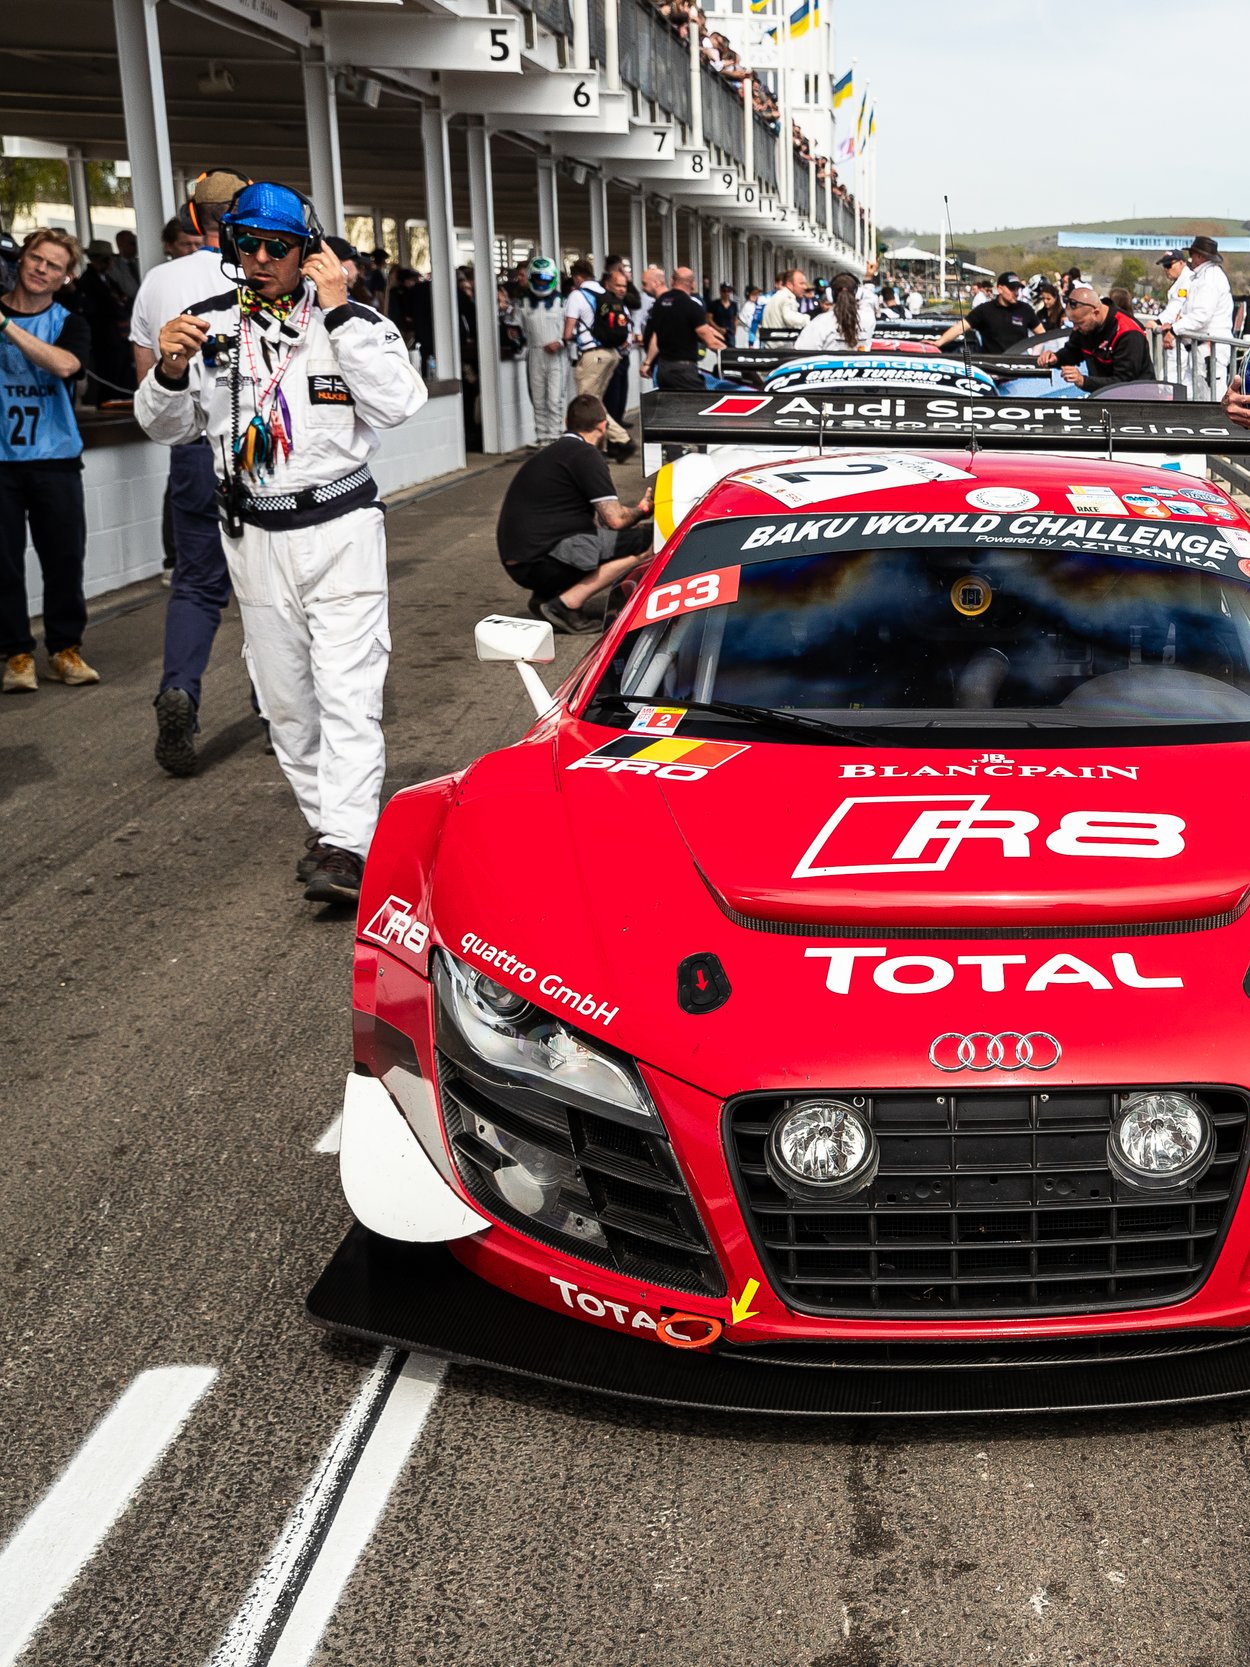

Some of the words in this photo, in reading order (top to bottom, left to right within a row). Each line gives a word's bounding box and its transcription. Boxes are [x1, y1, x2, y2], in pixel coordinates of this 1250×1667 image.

[490, 29, 510, 62] 5
[573, 81, 591, 107] 6
[653, 132, 667, 152] 7
[692, 155, 704, 173] 8
[723, 173, 732, 189] 9
[737, 187, 754, 202] 10
[759, 199, 772, 212] 11
[806, 369, 858, 381] GRAN
[4, 384, 58, 398] TRACK
[776, 397, 906, 417] Audi
[926, 400, 1082, 421] Sport
[8, 405, 40, 446] 27
[773, 418, 1044, 432] customer
[774, 463, 888, 483] 2
[740, 517, 860, 551] BAKU
[862, 514, 1002, 535] WORLD
[1009, 516, 1230, 560] CHALLENGE
[976, 534, 1037, 545] Powered
[1039, 536, 1057, 546] by
[645, 573, 720, 619] C3
[483, 618, 541, 631] WRT
[656, 714, 671, 726] 2
[565, 757, 708, 781] PRO
[838, 764, 1139, 781] BLANCPAIN
[892, 810, 1186, 860] R8
[382, 910, 430, 954] R8
[460, 932, 537, 983] quattro
[539, 975, 620, 1026] GmbH
[804, 946, 1184, 995] TOTAL
